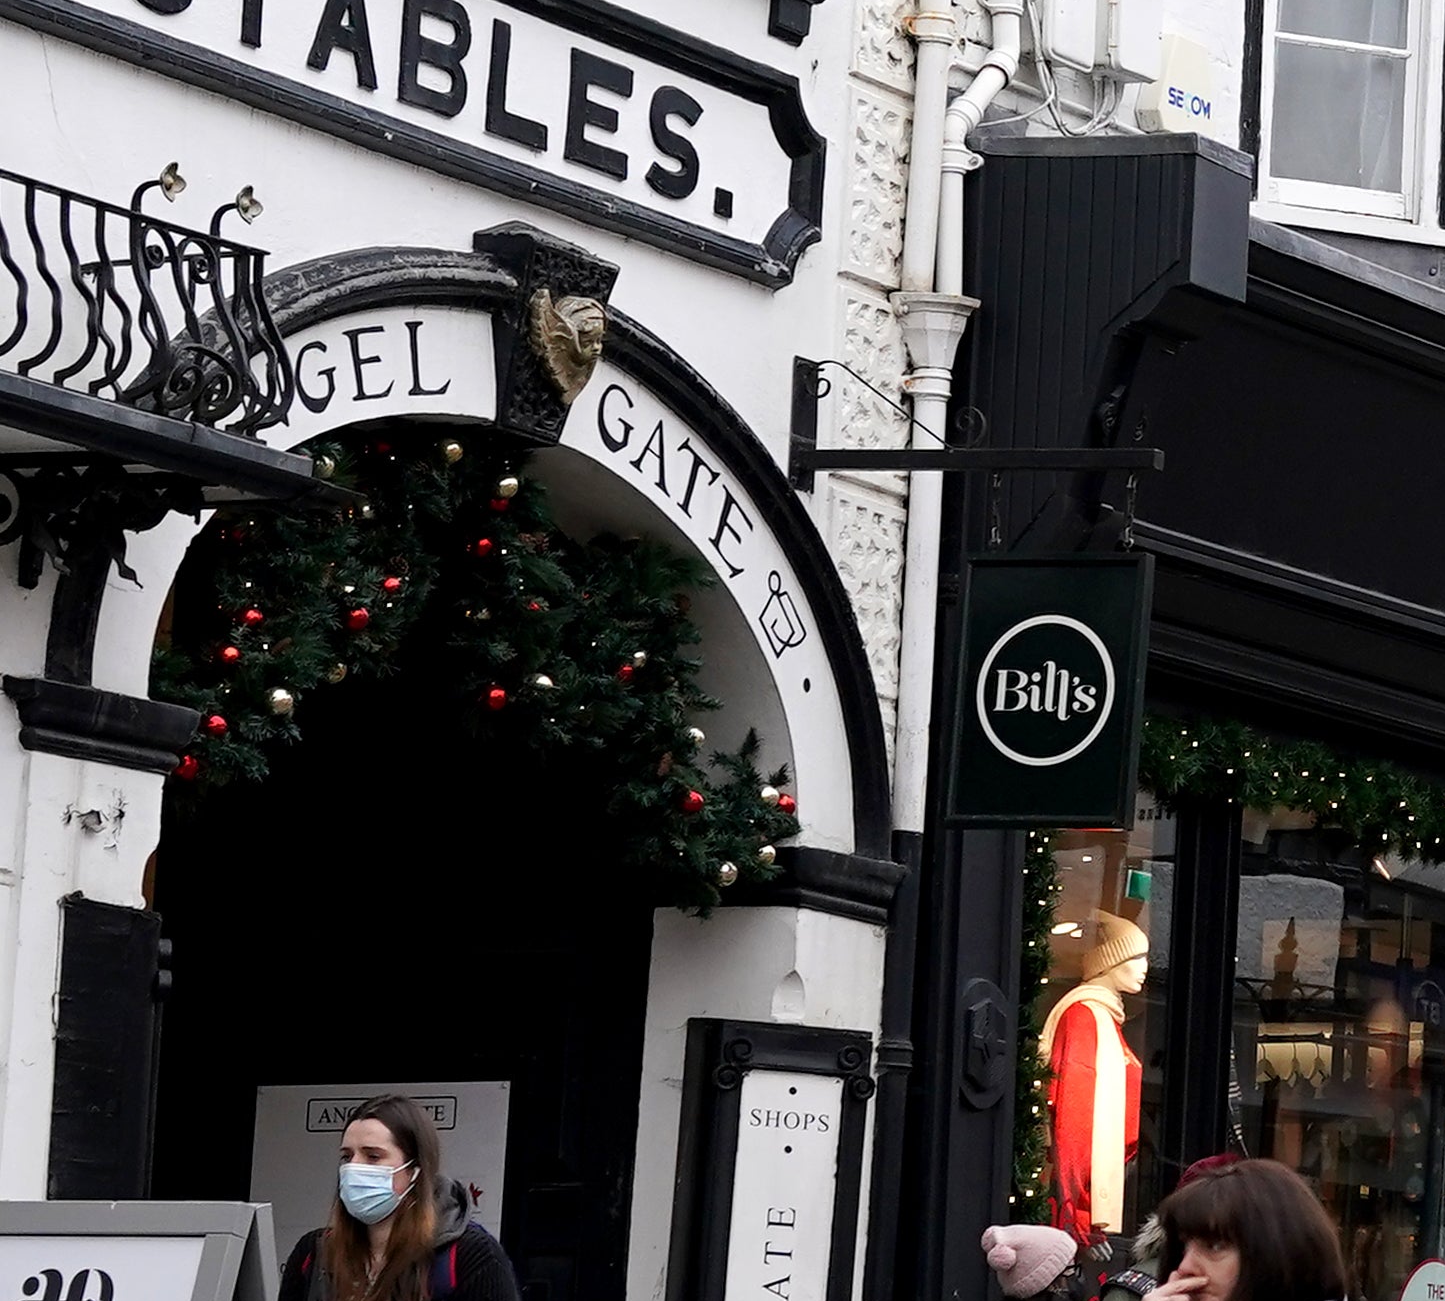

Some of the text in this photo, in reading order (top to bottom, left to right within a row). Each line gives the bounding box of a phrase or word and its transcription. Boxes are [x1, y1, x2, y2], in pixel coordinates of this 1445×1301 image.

[1168, 86, 1212, 120] SECOM
[294, 320, 452, 414] GEL
[596, 382, 755, 579] GATE
[993, 660, 1098, 721] Bill's
[748, 1107, 830, 1133] SHOPS
[1427, 1284, 1445, 1300] THE
